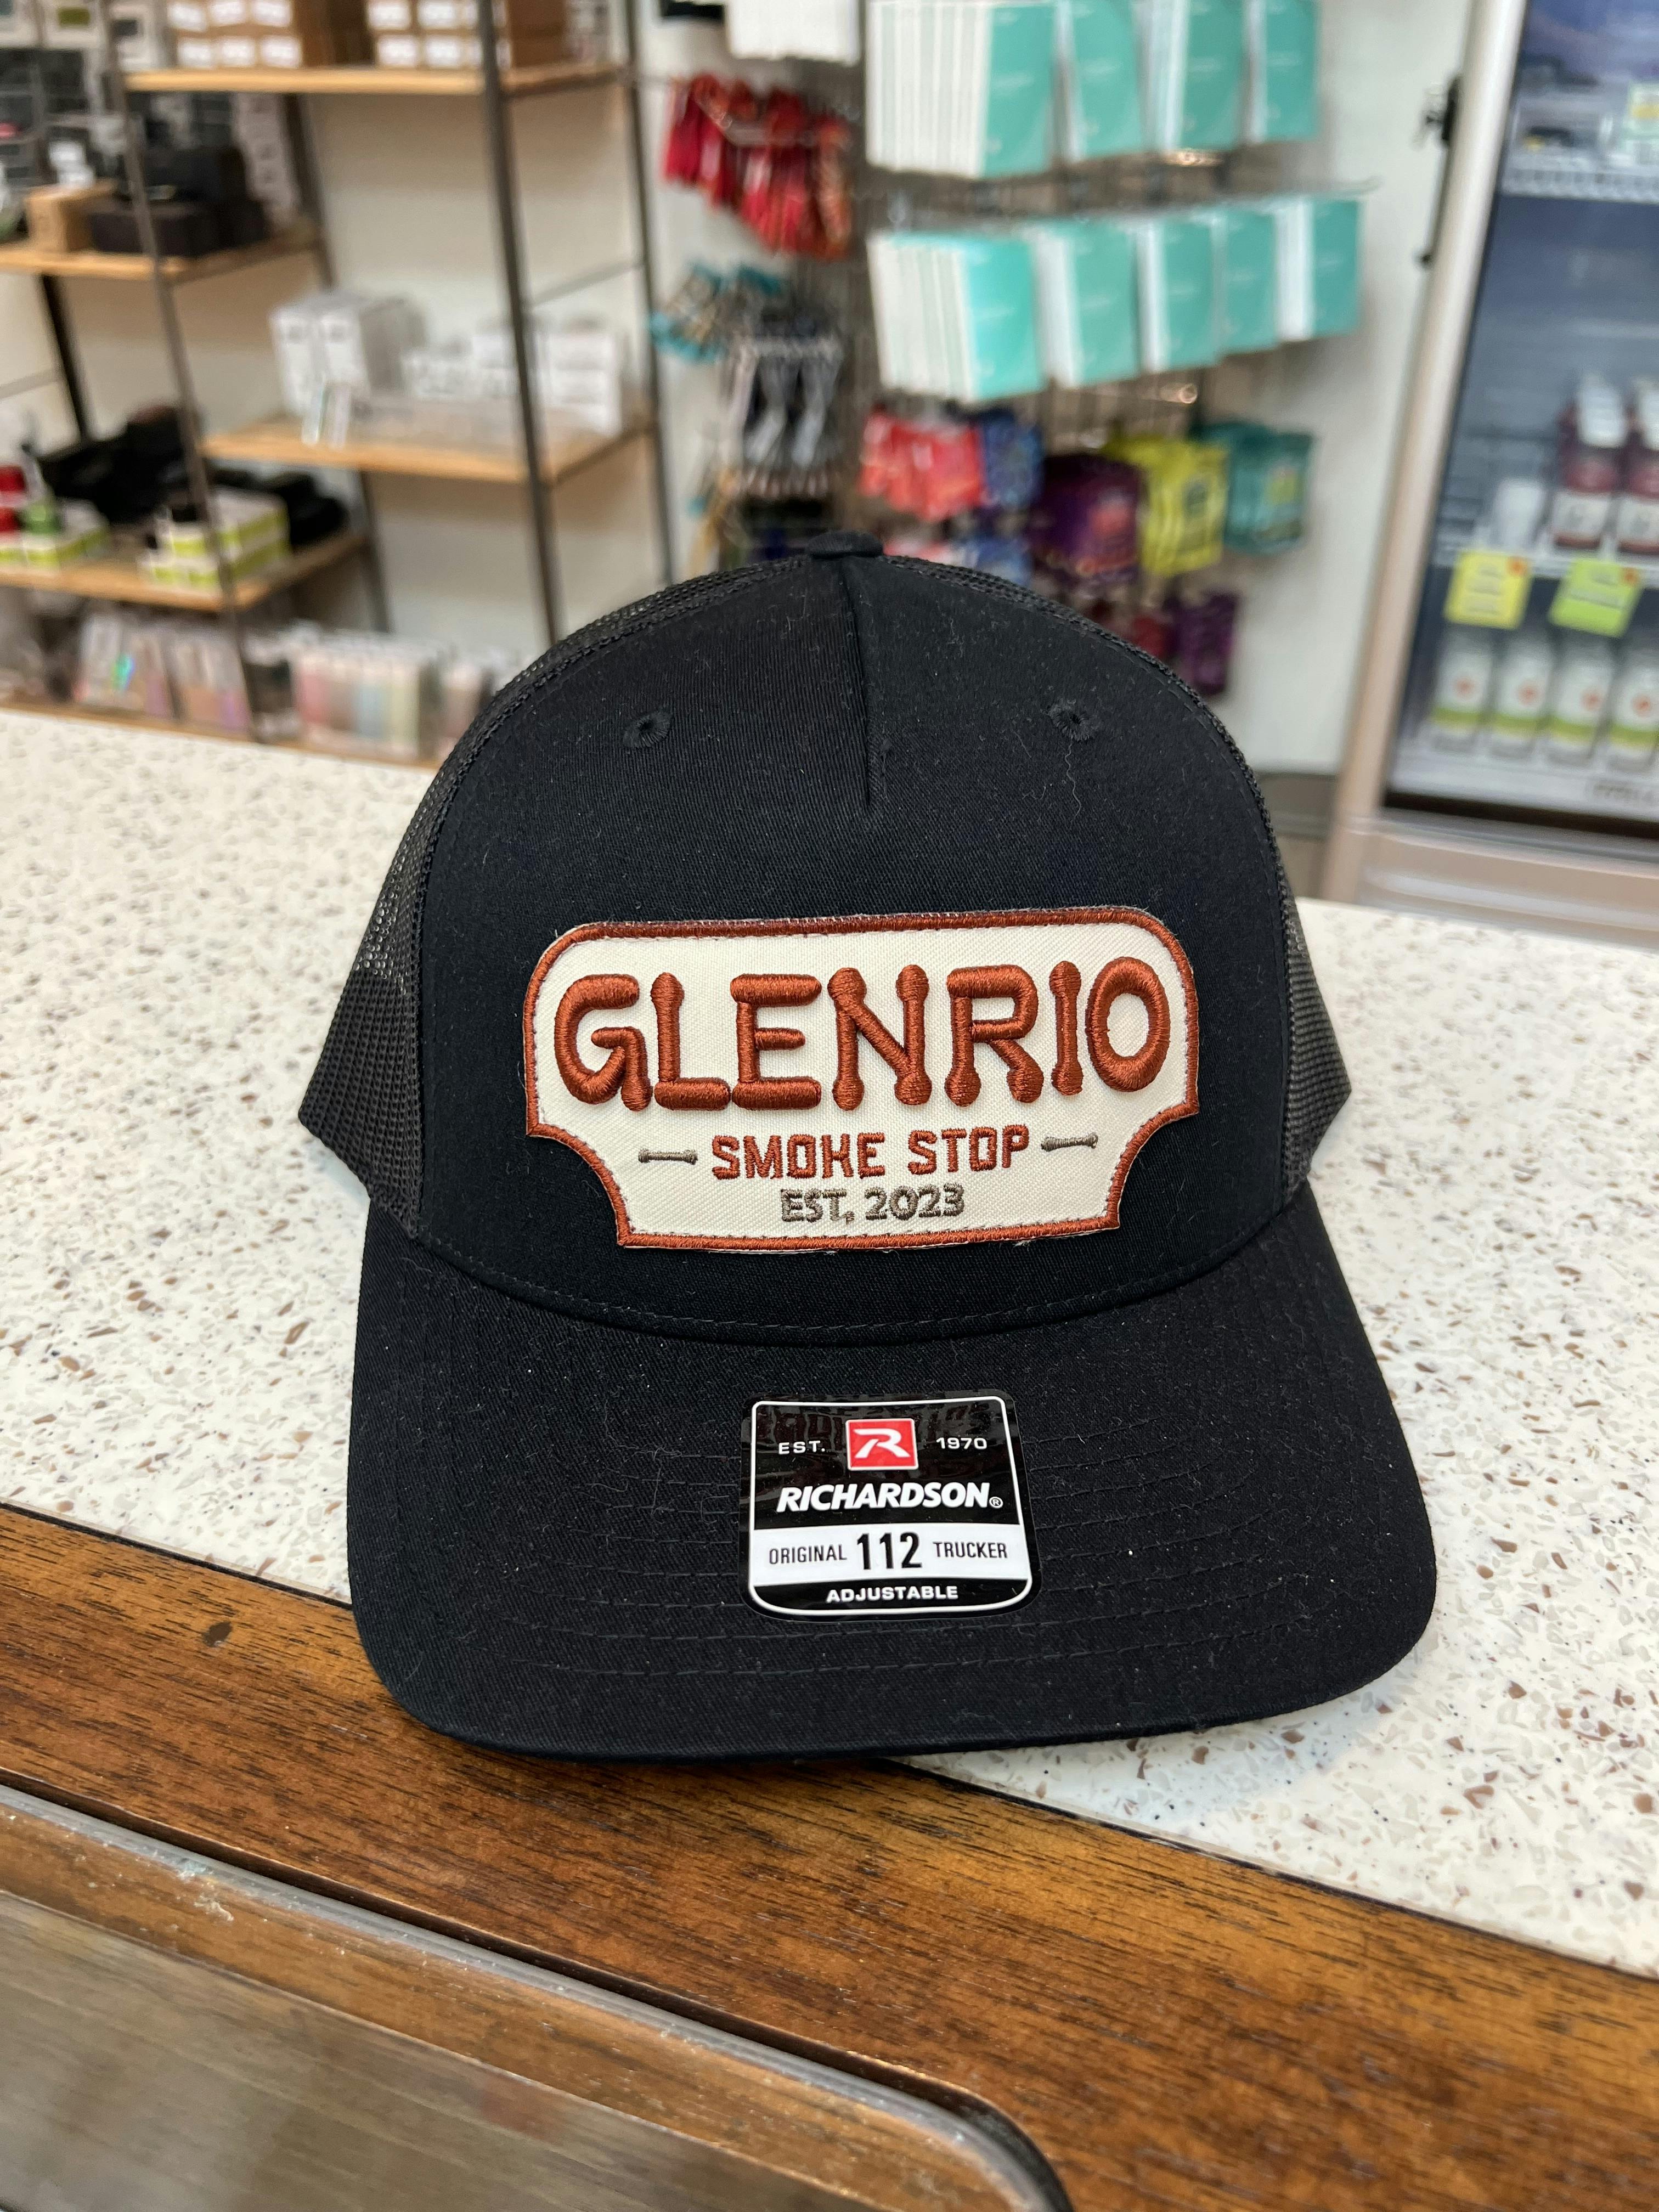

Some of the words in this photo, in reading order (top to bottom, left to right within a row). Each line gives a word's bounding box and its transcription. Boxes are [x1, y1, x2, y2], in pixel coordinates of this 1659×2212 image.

[554, 956, 1171, 1111] GLENRIO
[712, 1131, 886, 1180] SMOKE
[907, 1124, 1030, 1176] STOP
[864, 1183, 966, 1221] 2023
[778, 1440, 826, 1455] EST.
[935, 1437, 988, 1450] 1970
[769, 1544, 848, 1565] ORIGINAL
[856, 1531, 923, 1571] 112
[932, 1541, 1008, 1559] TRUCKER
[826, 1585, 959, 1603] ADJUSTABLE
